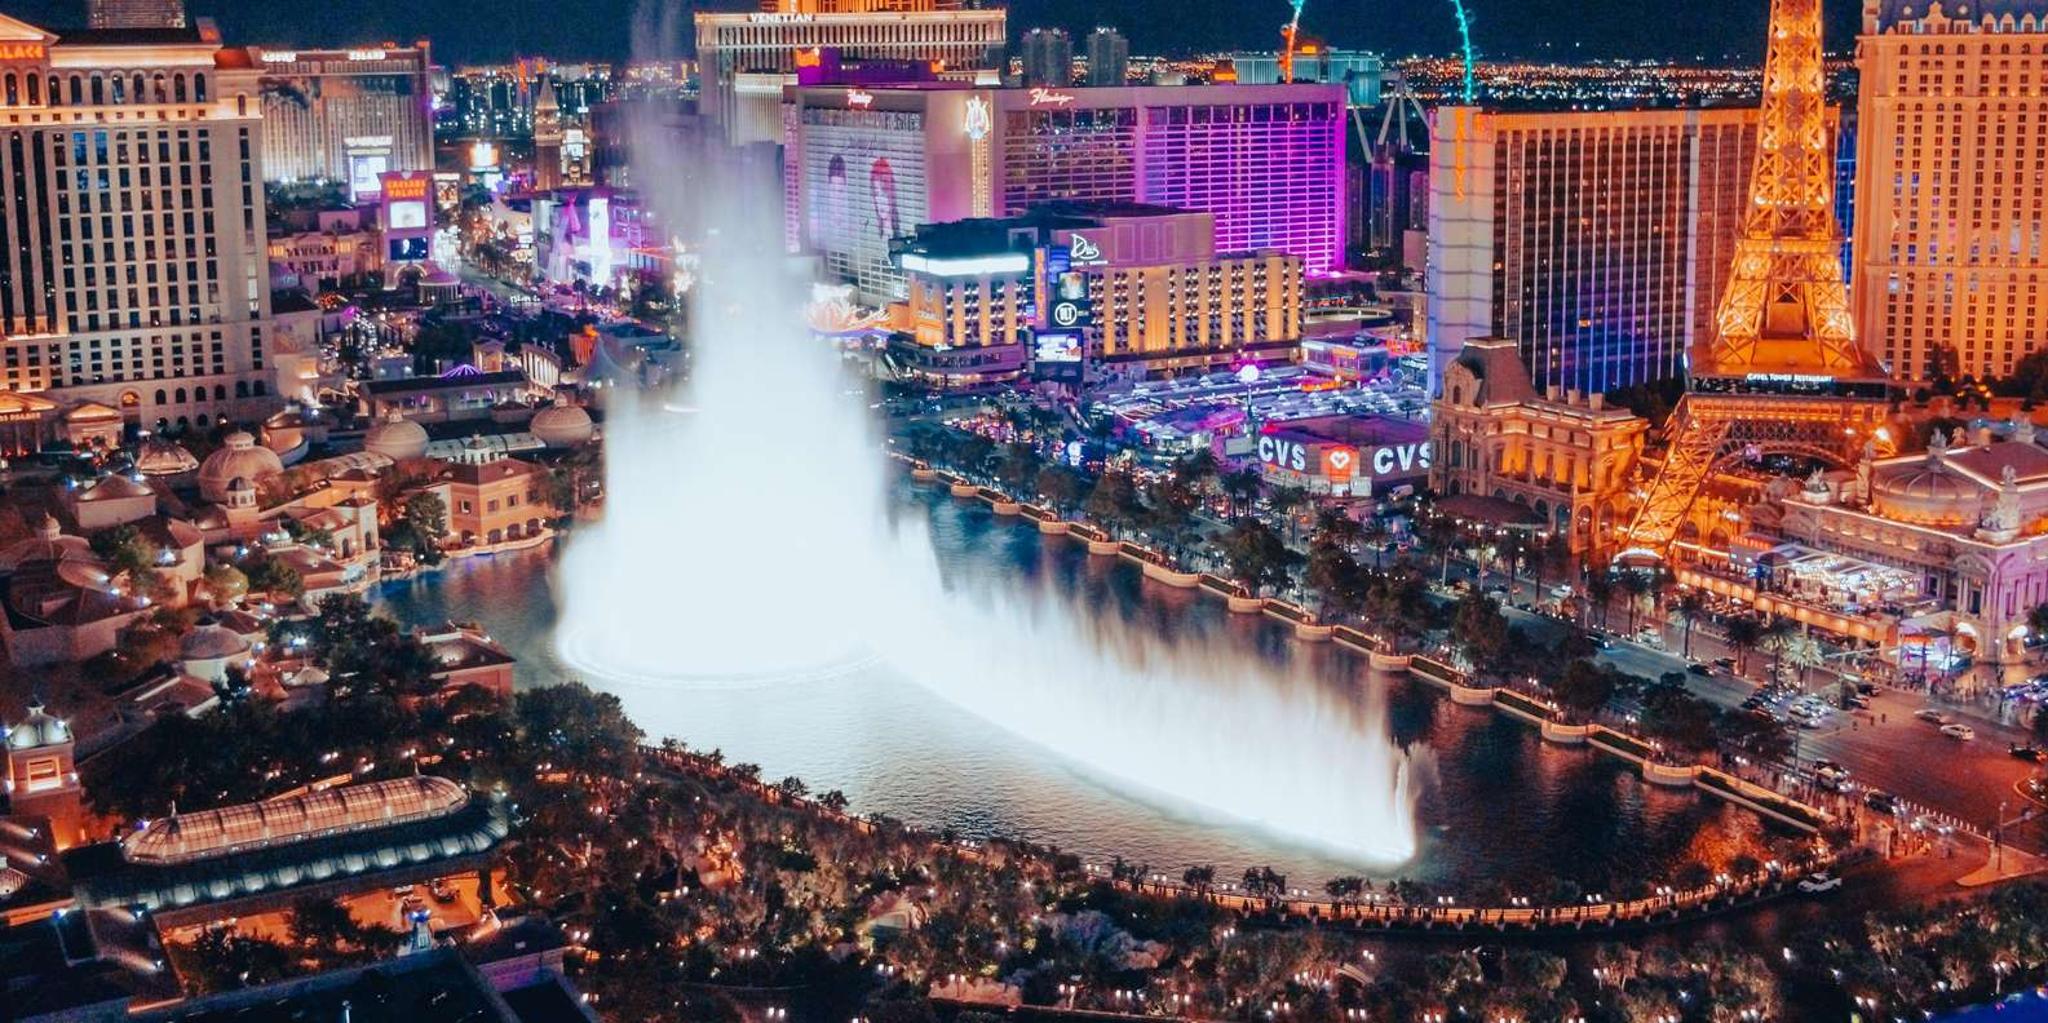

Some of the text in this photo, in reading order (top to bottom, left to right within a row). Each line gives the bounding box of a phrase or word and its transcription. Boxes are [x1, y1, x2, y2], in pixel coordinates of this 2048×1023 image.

[750, 13, 814, 23] VENETIAN
[389, 189, 424, 198] PALACE
[1258, 436, 1306, 471] CVS
[1374, 442, 1431, 475] CVS
